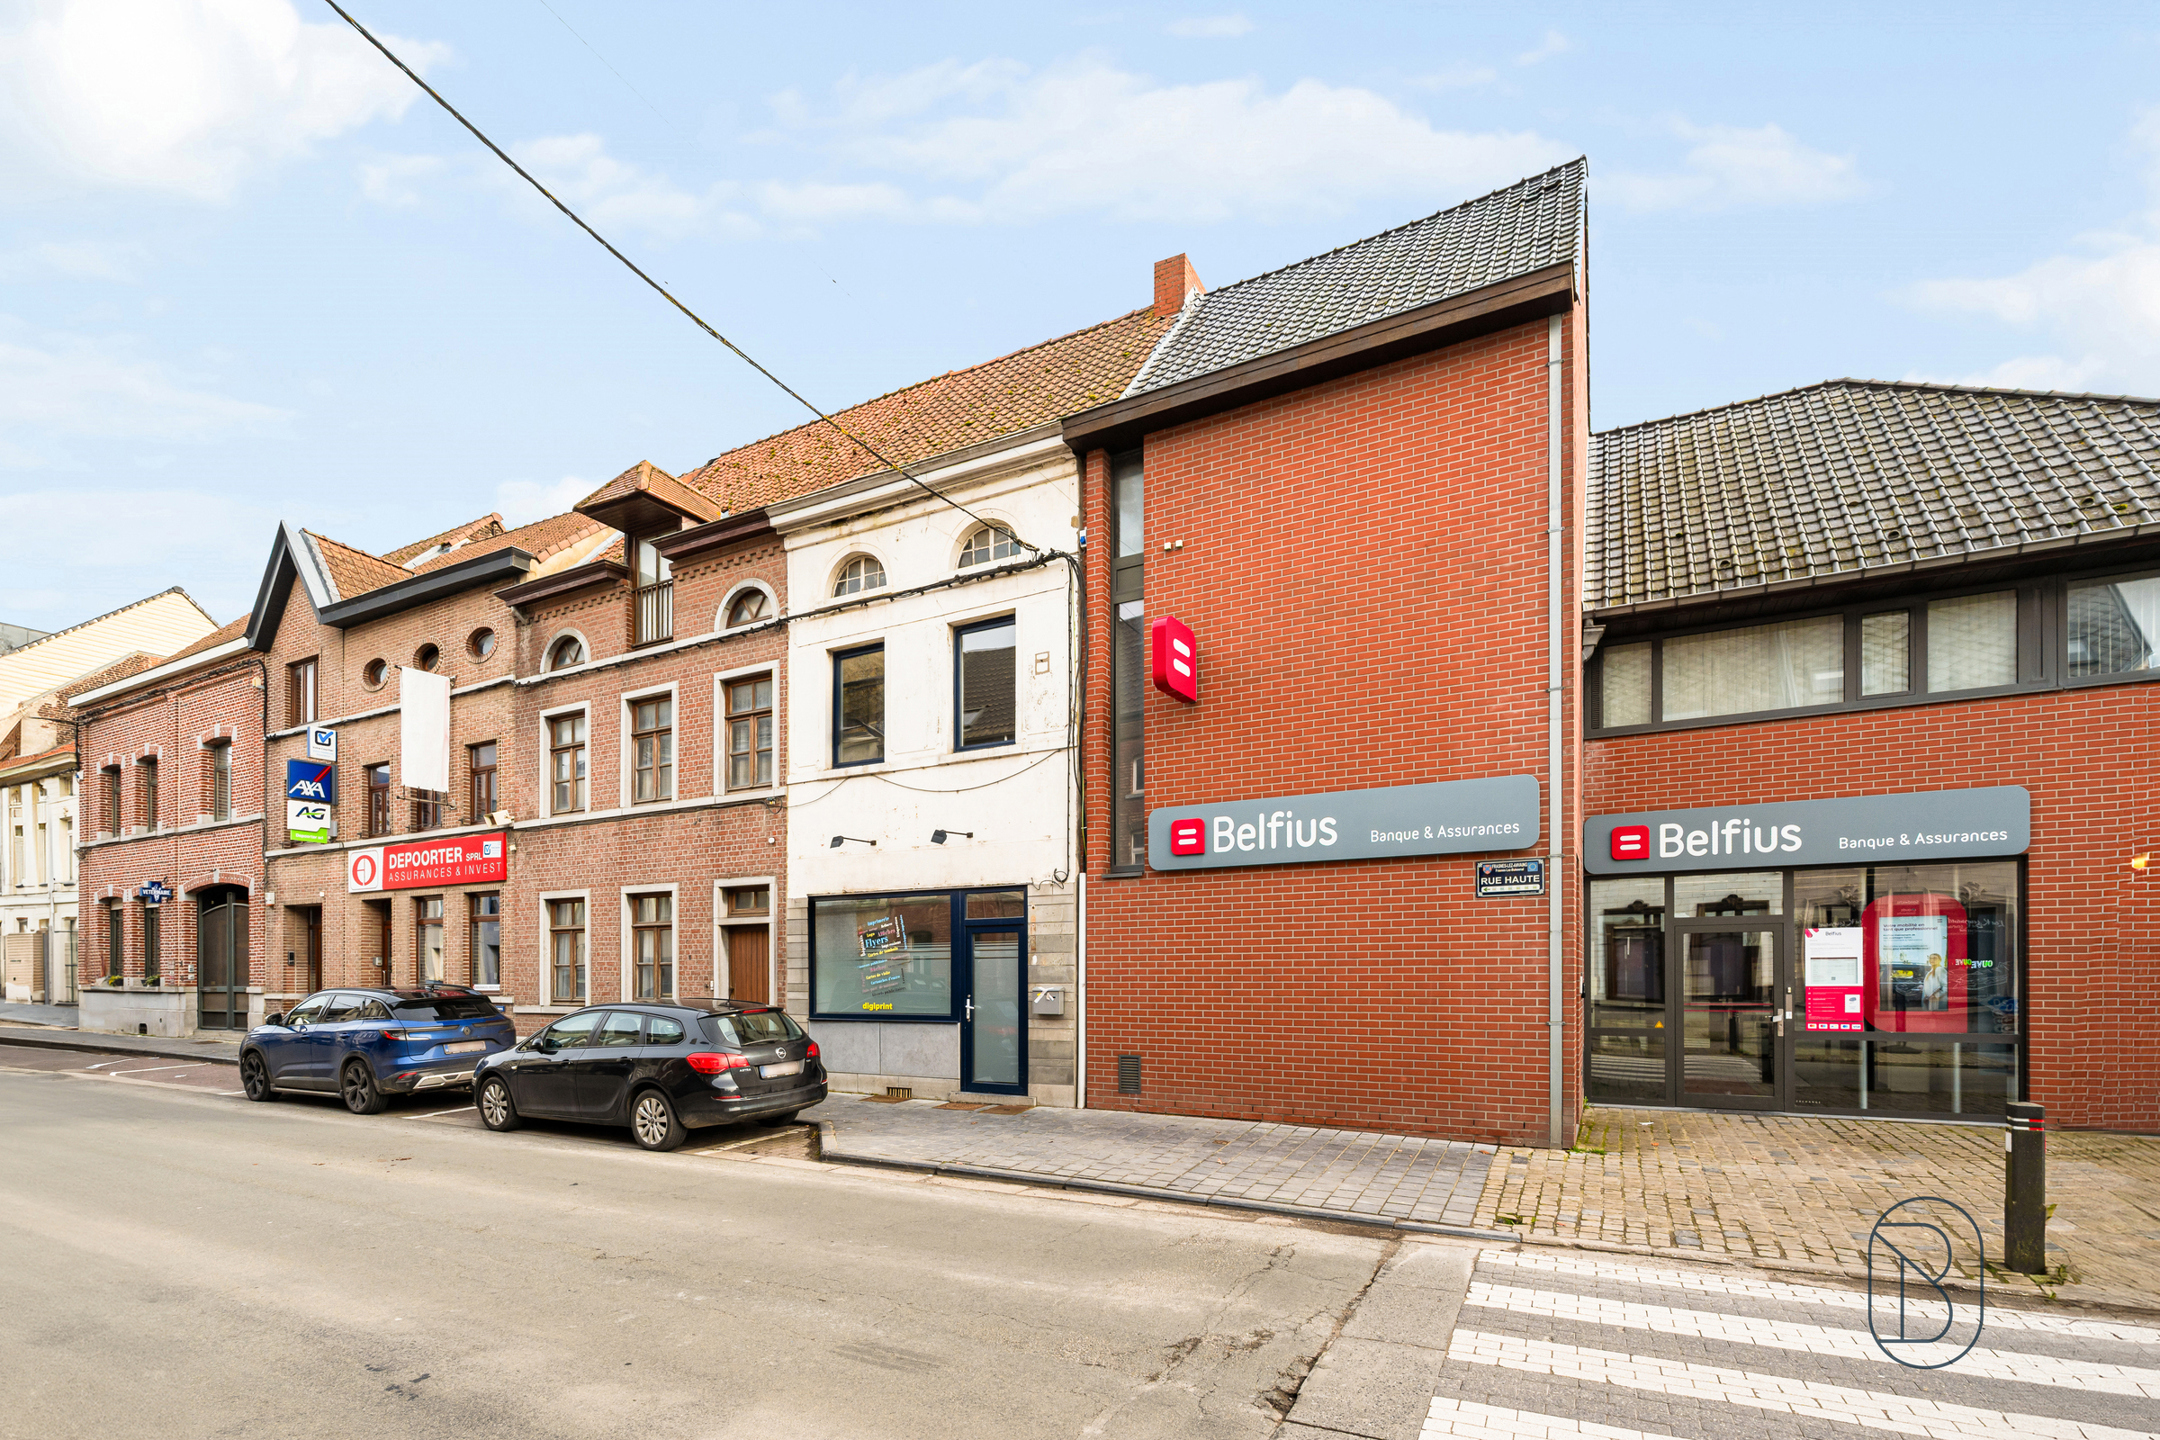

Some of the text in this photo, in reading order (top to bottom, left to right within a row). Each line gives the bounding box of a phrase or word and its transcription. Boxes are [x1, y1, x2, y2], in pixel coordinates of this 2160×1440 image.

[289, 780, 326, 799] AXA
[295, 806, 327, 820] AG
[1212, 810, 1520, 854] Belfius Banque & Assurances
[1658, 818, 2008, 859] Belfius Banque & Assurances
[389, 847, 483, 870] DEPOORTER SPRL
[388, 861, 502, 883] ASSURANCES & INVEST
[1481, 874, 1540, 886] RUE HAUTE
[867, 916, 890, 926] Imprimerie
[878, 929, 896, 937] Affiches
[865, 936, 889, 949] Flyers
[862, 1002, 894, 1012] digiprint
